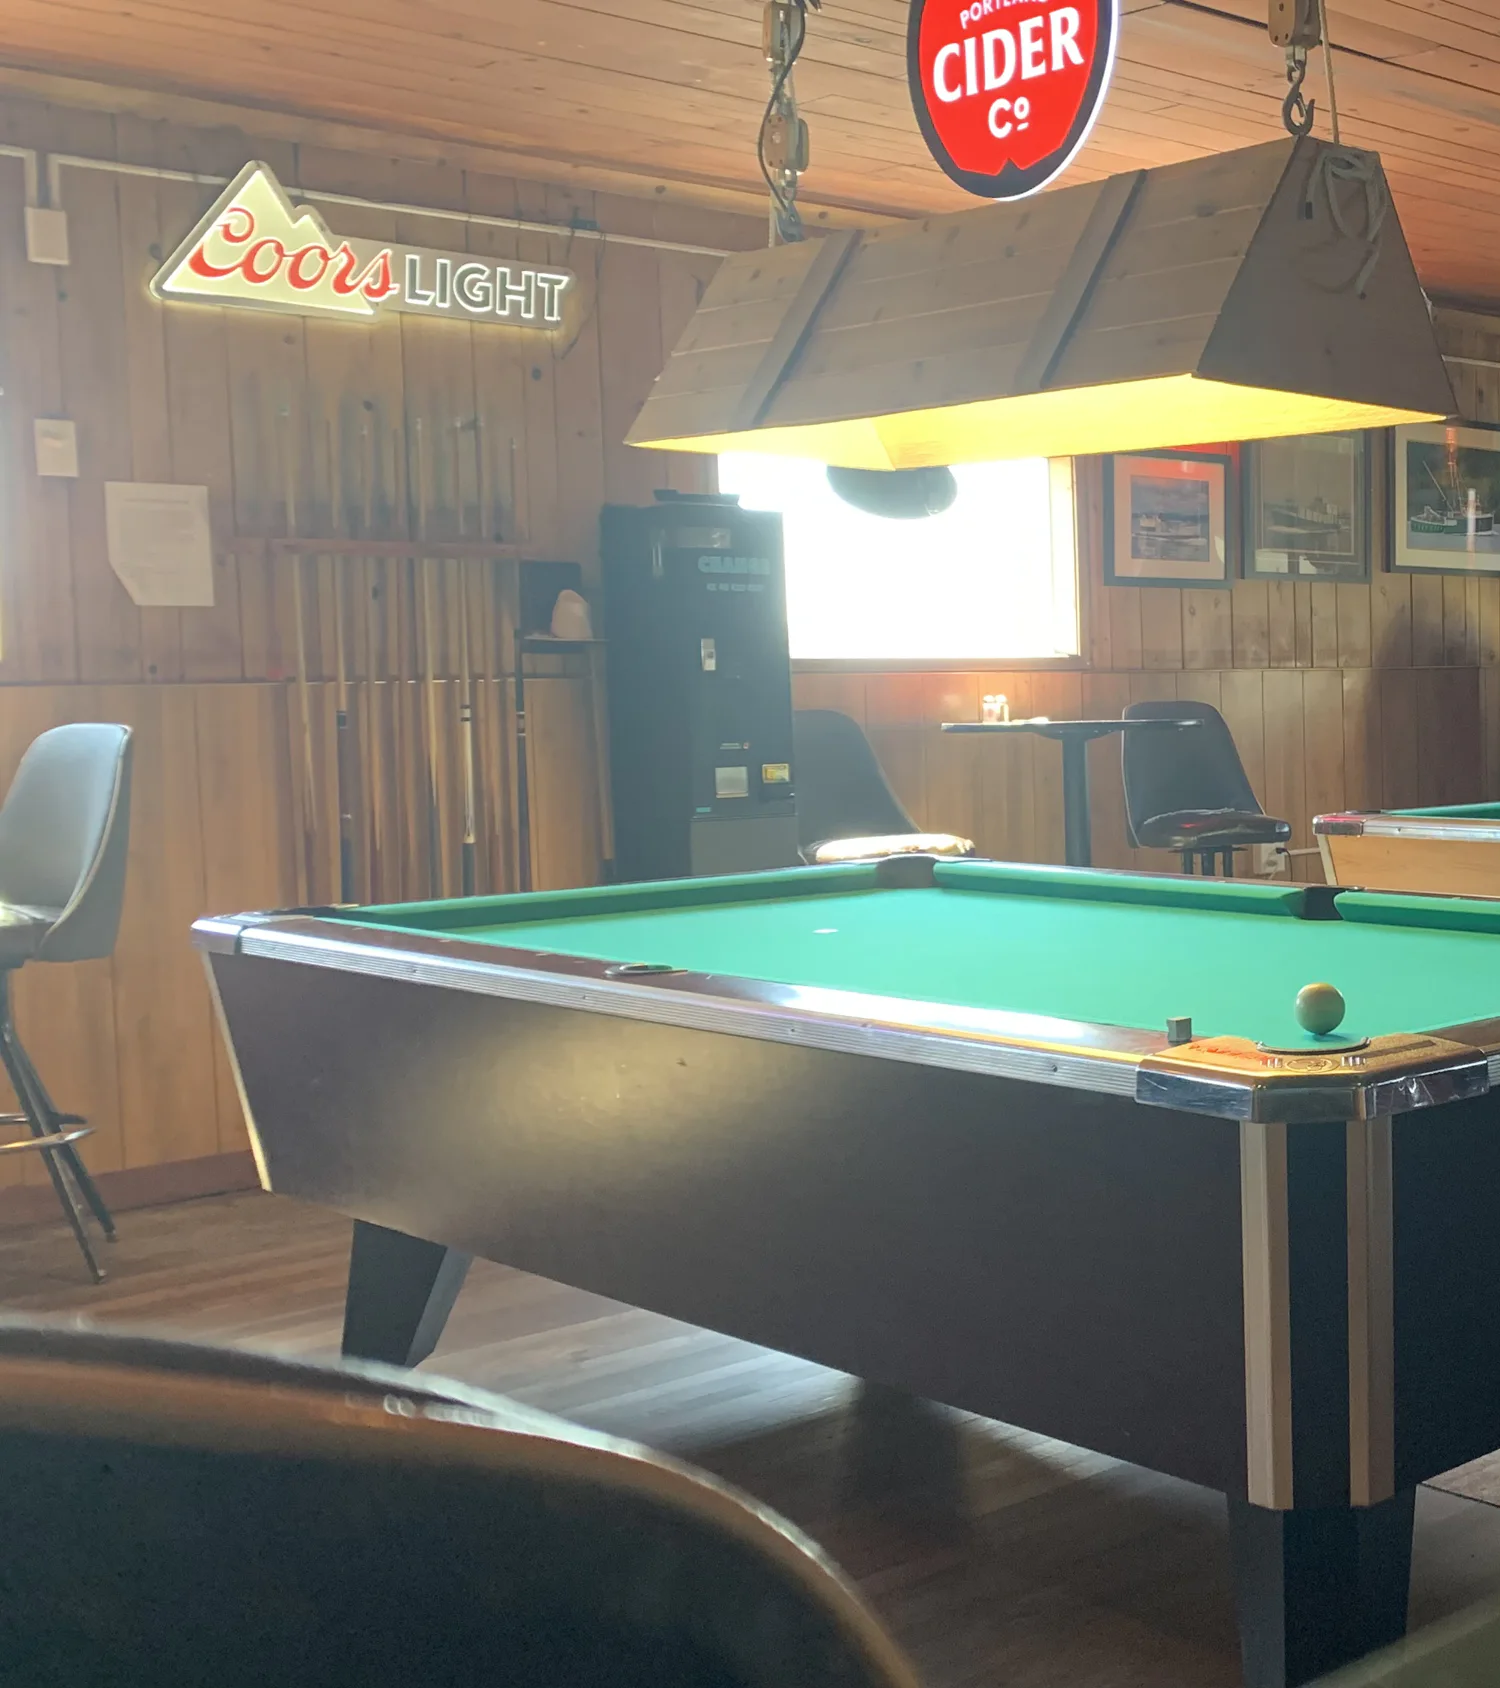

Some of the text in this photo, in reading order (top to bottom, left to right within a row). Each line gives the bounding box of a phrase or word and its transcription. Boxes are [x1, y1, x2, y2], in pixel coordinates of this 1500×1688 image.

[932, 7, 1085, 103] CIDER
[187, 207, 570, 321] Coors LIGHT
